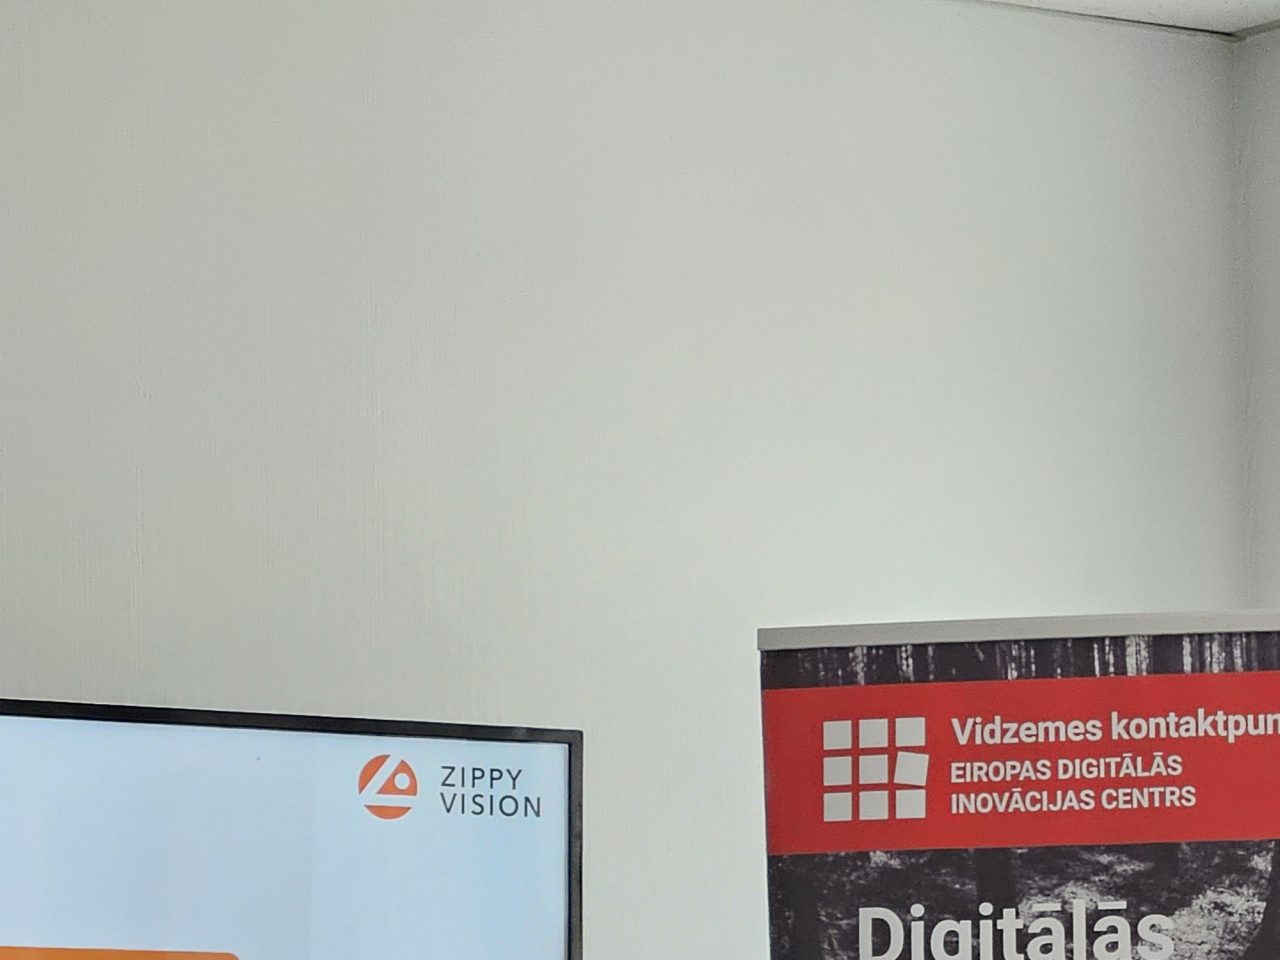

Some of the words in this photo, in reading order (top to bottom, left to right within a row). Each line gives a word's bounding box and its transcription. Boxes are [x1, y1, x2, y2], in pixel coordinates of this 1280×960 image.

[951, 713, 1102, 745] Vidzemes
[441, 766, 522, 790] ZIPPY
[951, 761, 1051, 783] EIROPAS
[1058, 754, 1183, 780] DIGITĀLĀS
[440, 793, 542, 818] VISION
[951, 786, 1095, 814] INOVĀCIJAS
[1101, 786, 1196, 809] CENTRS
